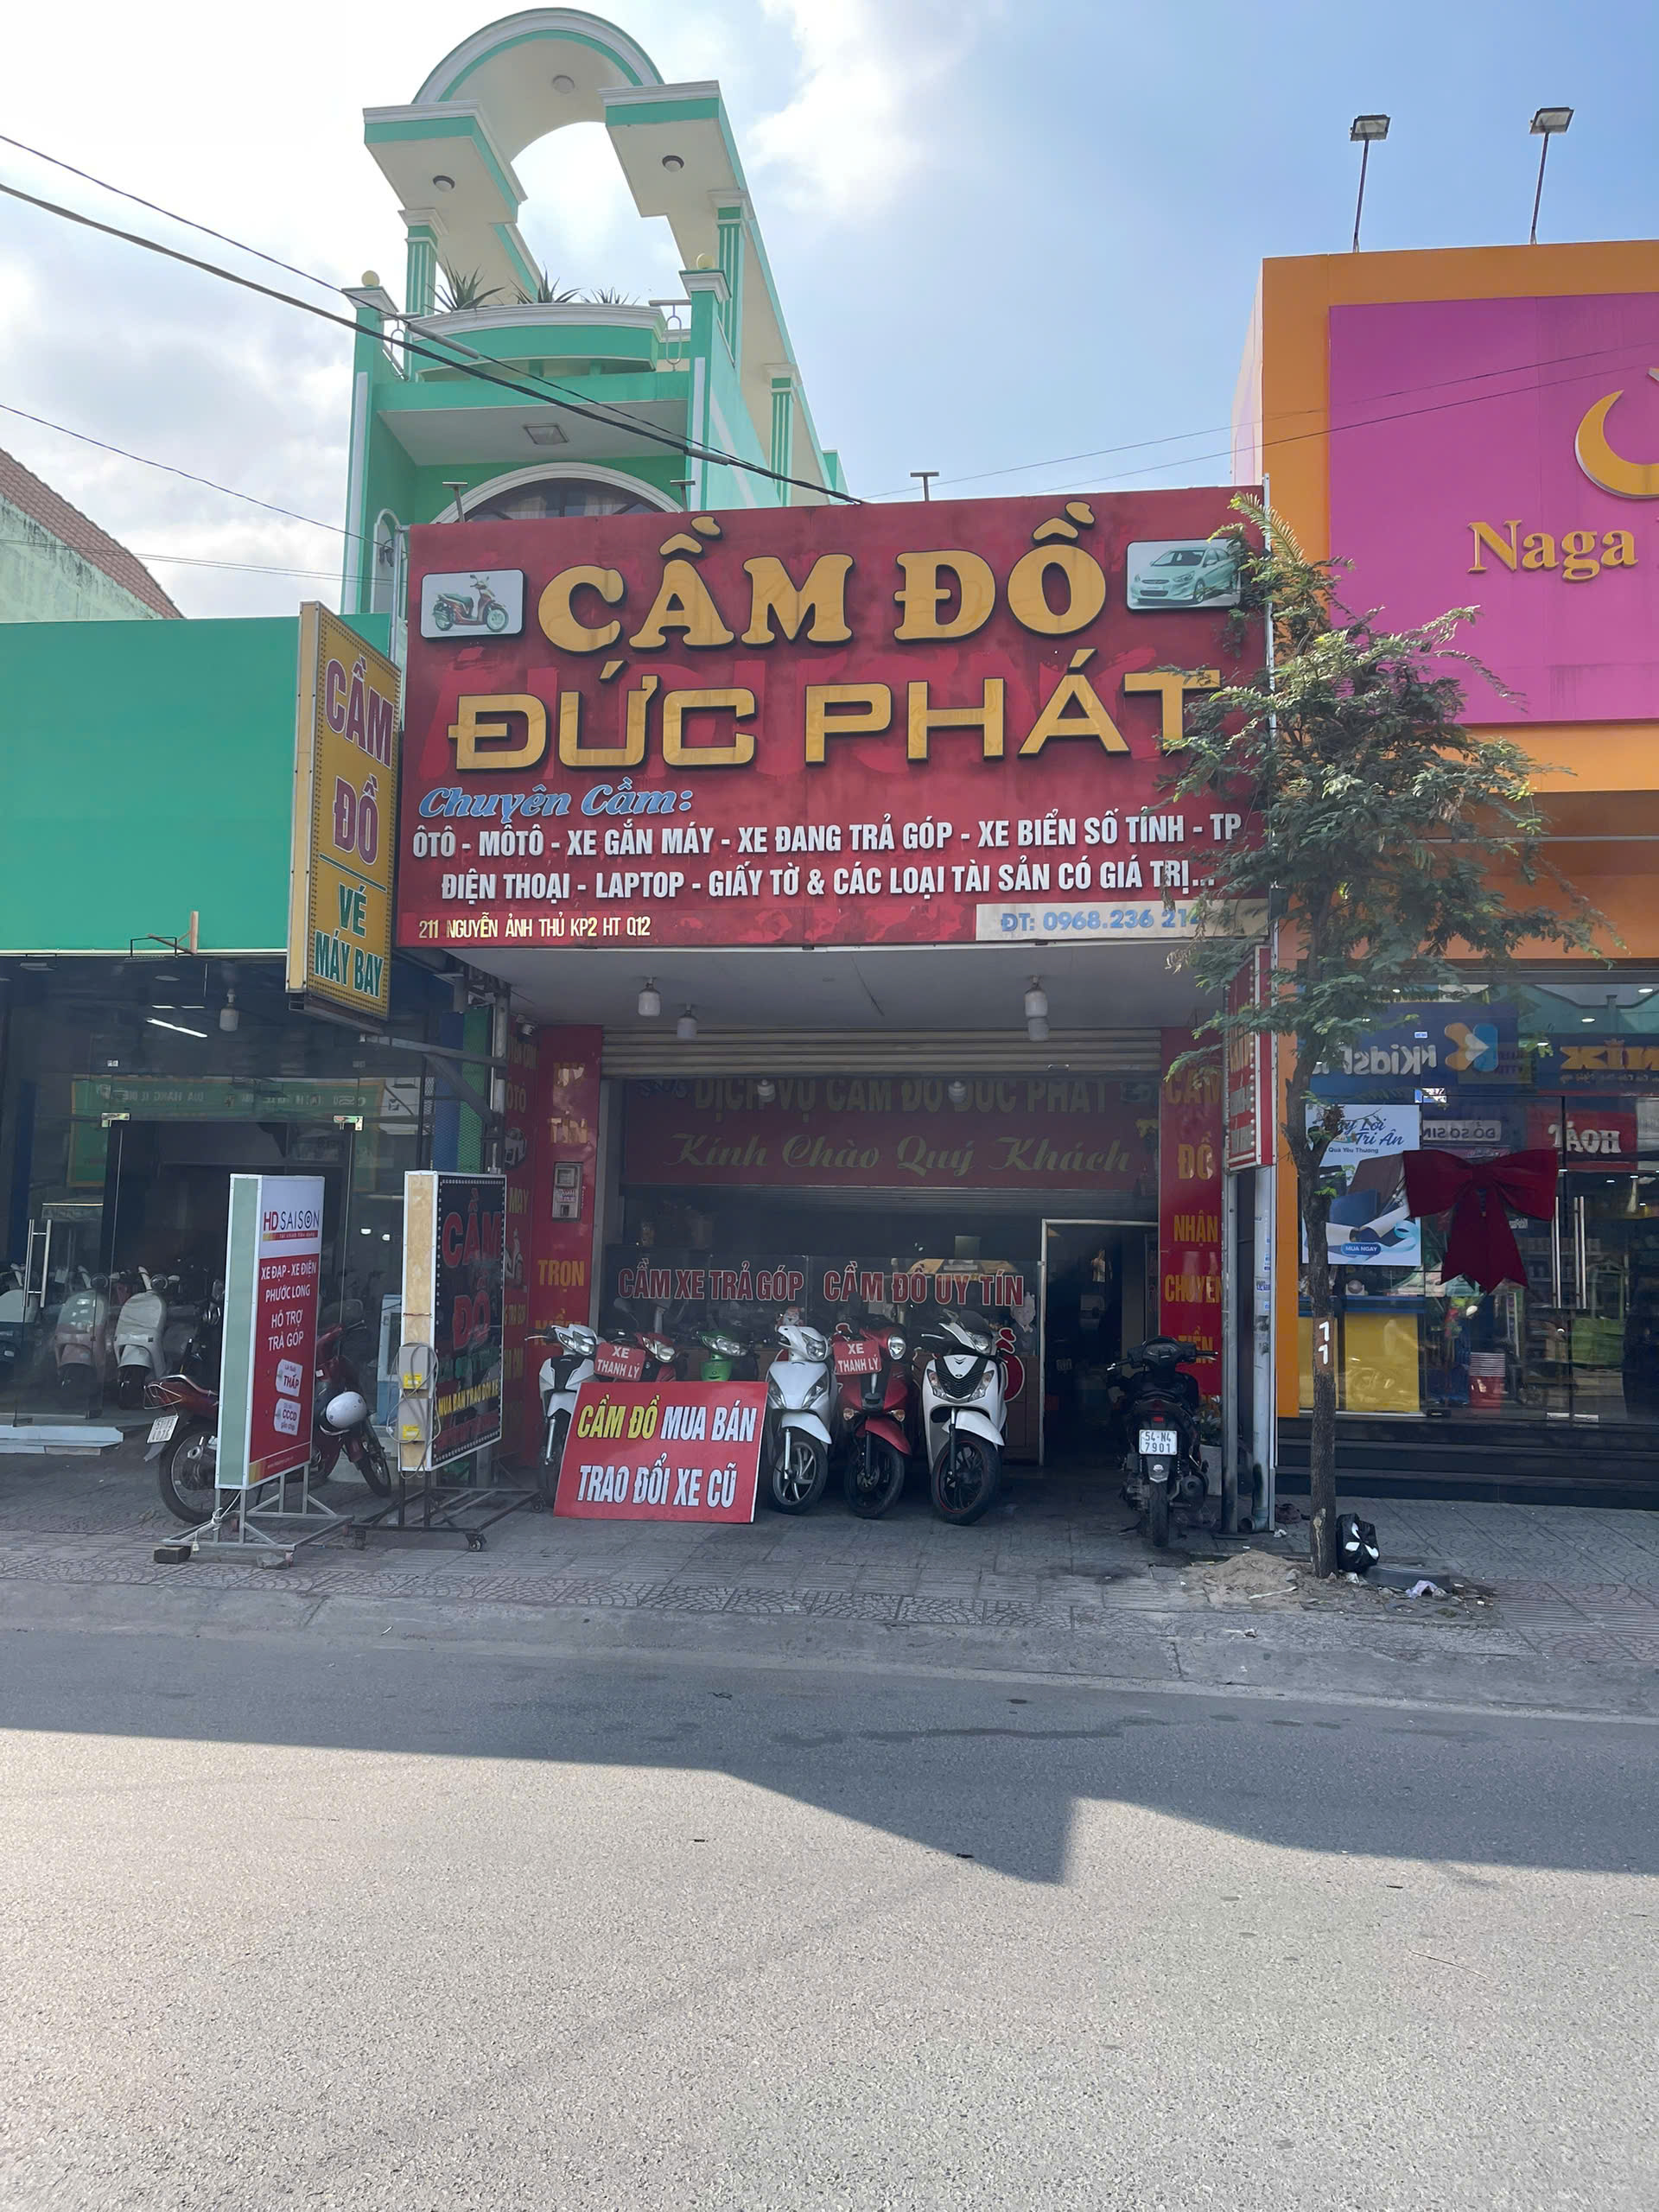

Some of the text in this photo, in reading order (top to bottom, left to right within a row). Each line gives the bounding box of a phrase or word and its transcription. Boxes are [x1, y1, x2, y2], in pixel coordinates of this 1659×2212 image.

[1466, 518, 1639, 582] Naga
[537, 501, 1107, 654] CẦM ĐỒ
[325, 653, 395, 769] CẦM
[448, 648, 1221, 770] ĐỨC PHÁT
[418, 776, 693, 823] Chuyên Cầm:
[332, 773, 380, 866] ĐỒ
[413, 824, 456, 857] ÔTÔ
[479, 823, 543, 856] MÔTÔ
[567, 830, 597, 856] XE
[604, 818, 652, 855] GẮN
[661, 822, 714, 854] MÁY
[738, 827, 768, 853] XE
[775, 825, 842, 852] ĐANG
[849, 813, 895, 850] TRẢ
[902, 816, 952, 849] GÓP
[978, 820, 1009, 848] XE
[1017, 809, 1076, 846] BIỂN
[1084, 808, 1120, 845] SỐ
[1210, 813, 1242, 841] TP
[442, 868, 496, 905] ĐIỆN
[503, 873, 570, 904] THOẠI
[596, 872, 684, 899] LAPTOP
[709, 861, 763, 897] GIẤY
[770, 862, 800, 896] TỜ
[807, 868, 825, 895] &
[834, 861, 882, 895] CÁC
[890, 866, 944, 899] LOẠI
[951, 859, 990, 893] TÀI
[998, 855, 1050, 891] SẢN
[1058, 855, 1091, 890] CÓ
[1100, 854, 1142, 889] GIÁ
[338, 885, 367, 937] VÉ
[419, 911, 651, 938] 211 NGUYỄN ẢNH THỦ KP2 HT Q12
[1001, 912, 1035, 931] ĐT:
[1043, 908, 1154, 931] 0968.236
[314, 928, 385, 1000] MÁY BAY
[662, 1133, 768, 1167] Kính
[781, 1133, 880, 1169] Chào
[988, 1135, 1133, 1173] Khách
[1178, 1130, 1215, 1180] ĐỒ
[1355, 1131, 1377, 1146] Tri
[1379, 1128, 1406, 1147] Ân
[263, 1210, 320, 1231] HD SAISON
[1173, 1210, 1218, 1247] NHẬN
[261, 1266, 271, 1280] XE
[271, 1264, 287, 1282] ĐẠP
[291, 1262, 300, 1276] XE
[301, 1260, 317, 1278] ĐIỆN
[538, 1259, 585, 1293] TRỌN
[618, 1258, 804, 1301] CẦM XE TRẢ GÓP
[823, 1261, 1024, 1306] CẦM ĐỒ UY TÍN
[265, 1284, 311, 1303] PHƯỚC LONG
[270, 1309, 304, 1329] HỖ TRỢ
[268, 1327, 304, 1351] TRẢ GÓP
[612, 1345, 630, 1359] XE
[848, 1343, 864, 1355] XE
[597, 1358, 640, 1378] THANH LÝ
[837, 1354, 880, 1373] THANH LÝ
[577, 1394, 758, 1442] CẦM ĐỒ MUA BÁN
[1145, 1431, 1172, 1442] 54-N4
[1145, 1442, 1171, 1453] 7901
[577, 1452, 737, 1508] TRAO ĐỔI XE CŨ
